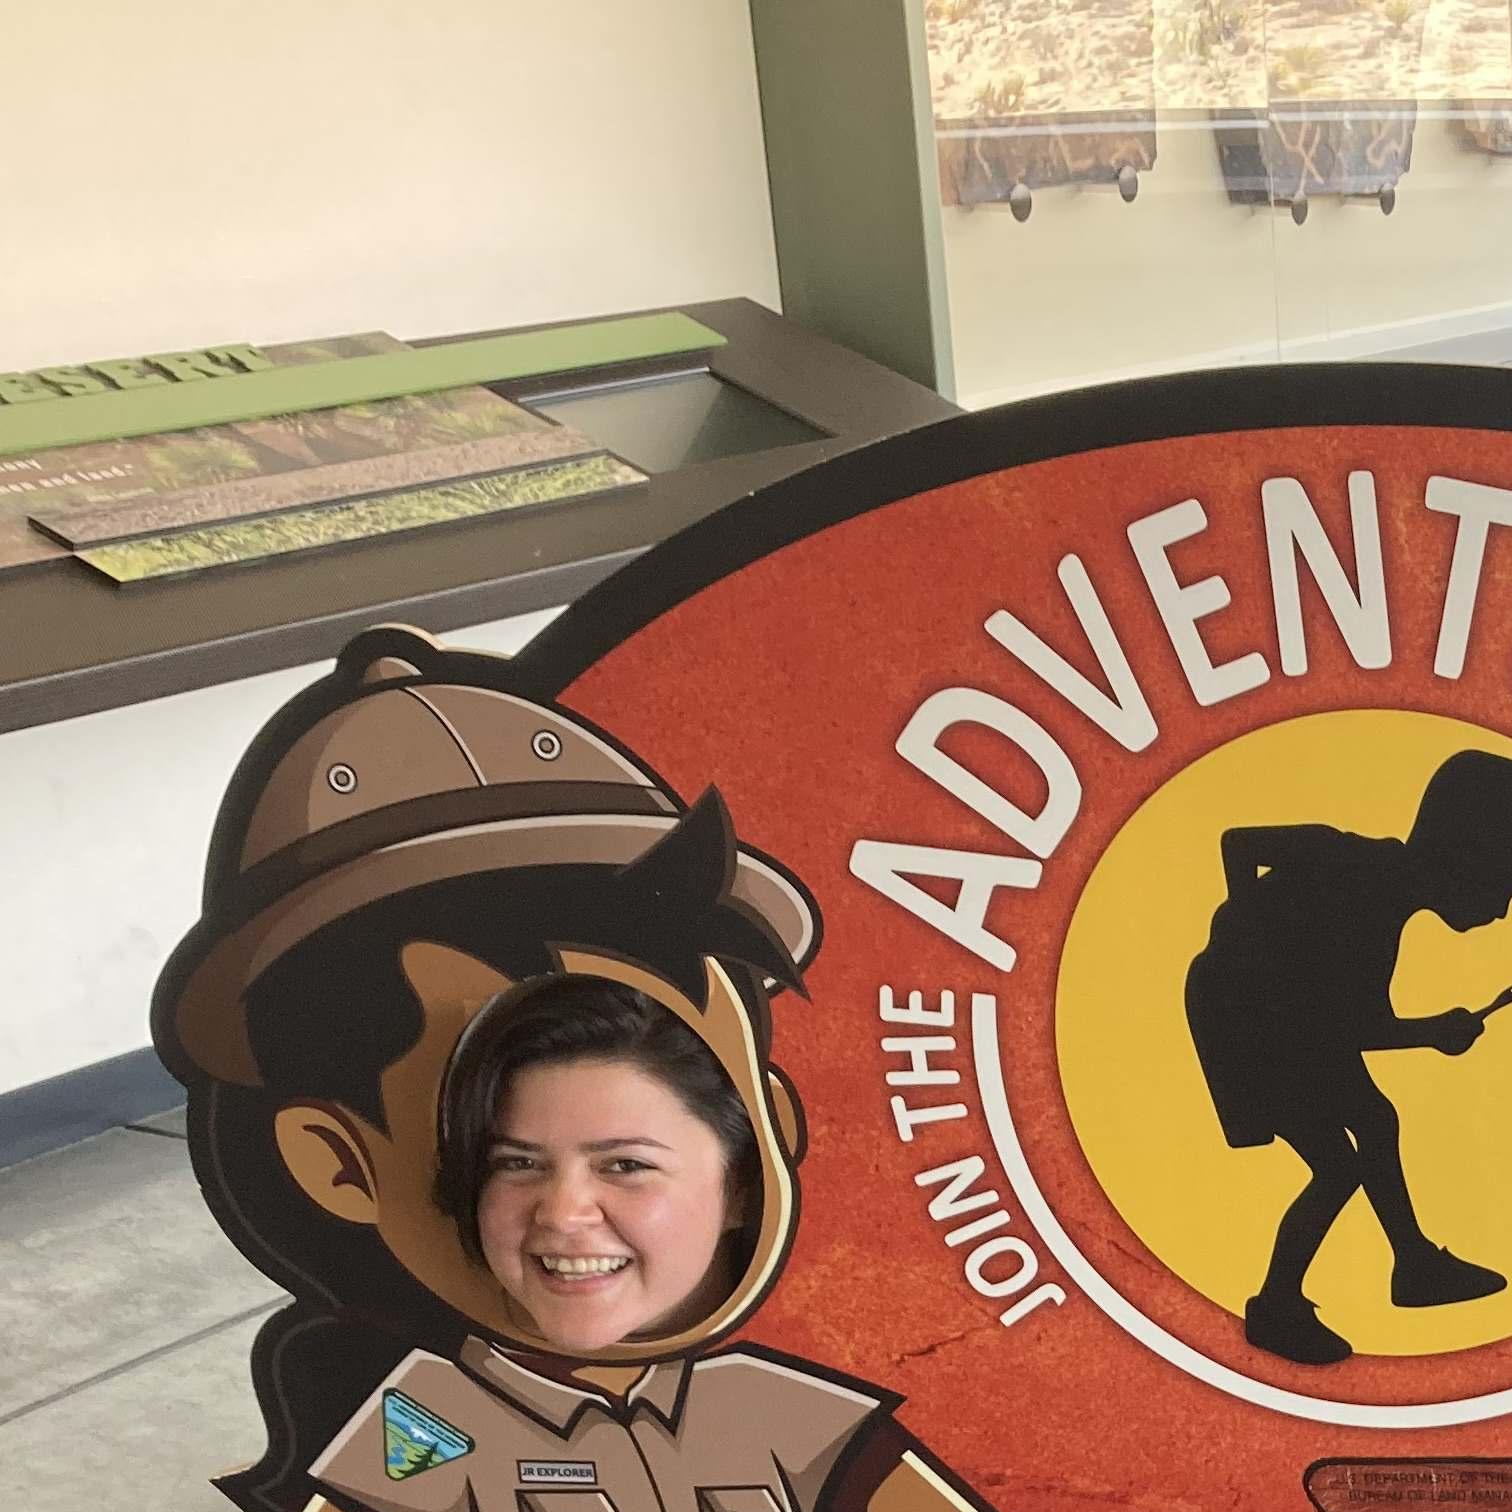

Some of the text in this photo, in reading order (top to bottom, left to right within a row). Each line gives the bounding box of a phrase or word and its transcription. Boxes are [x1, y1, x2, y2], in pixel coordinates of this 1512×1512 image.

[0, 342, 262, 404] ESERT
[879, 985, 968, 1142] THE
[914, 1155, 1066, 1328] JOIN
[523, 1467, 593, 1477] JR EXPLORER
[1363, 1472, 1452, 1484] DEPARTMENT
